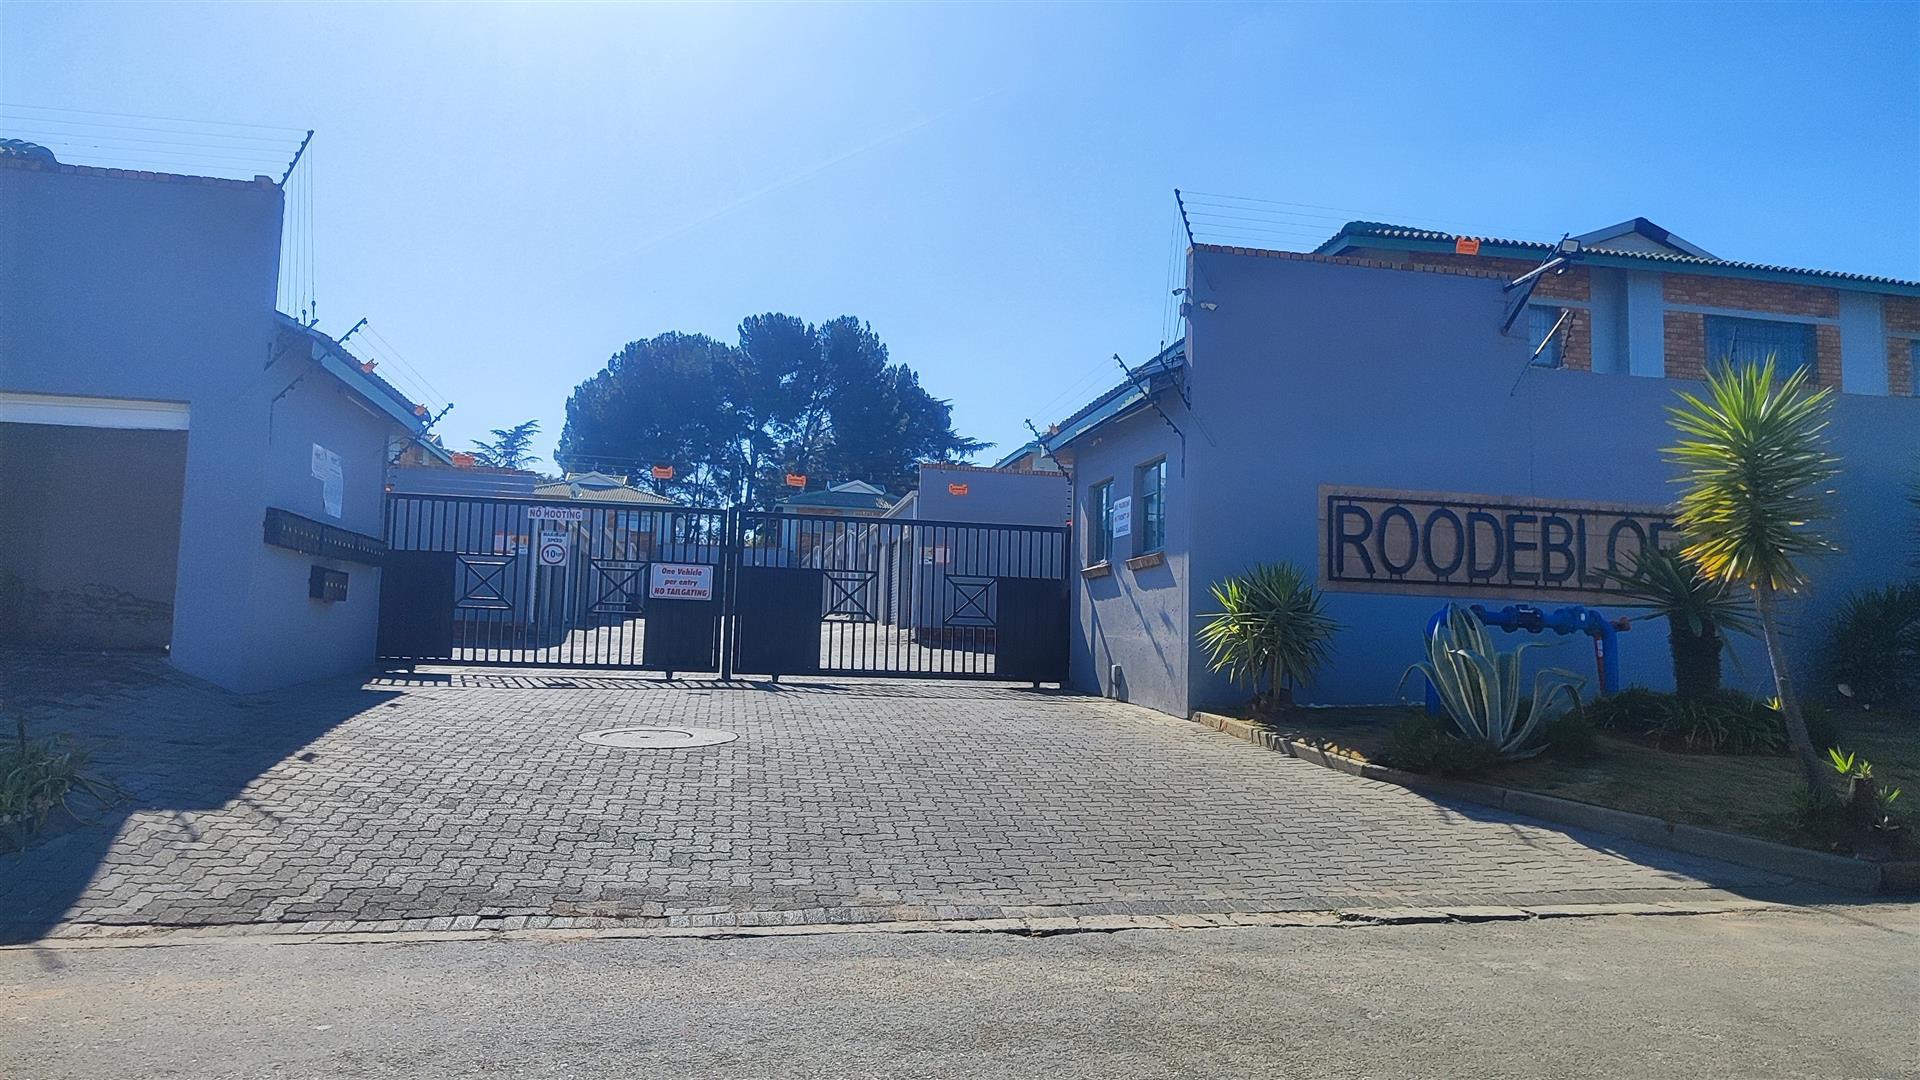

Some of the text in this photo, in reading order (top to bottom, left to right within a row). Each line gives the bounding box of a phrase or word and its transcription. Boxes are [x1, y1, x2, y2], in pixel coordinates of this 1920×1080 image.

[529, 508, 581, 520] NO HOOTING
[545, 550, 556, 558] 10
[661, 567, 703, 576] One Vehicle
[678, 579, 698, 587] entry
[653, 587, 708, 597] NO TAILGATING
